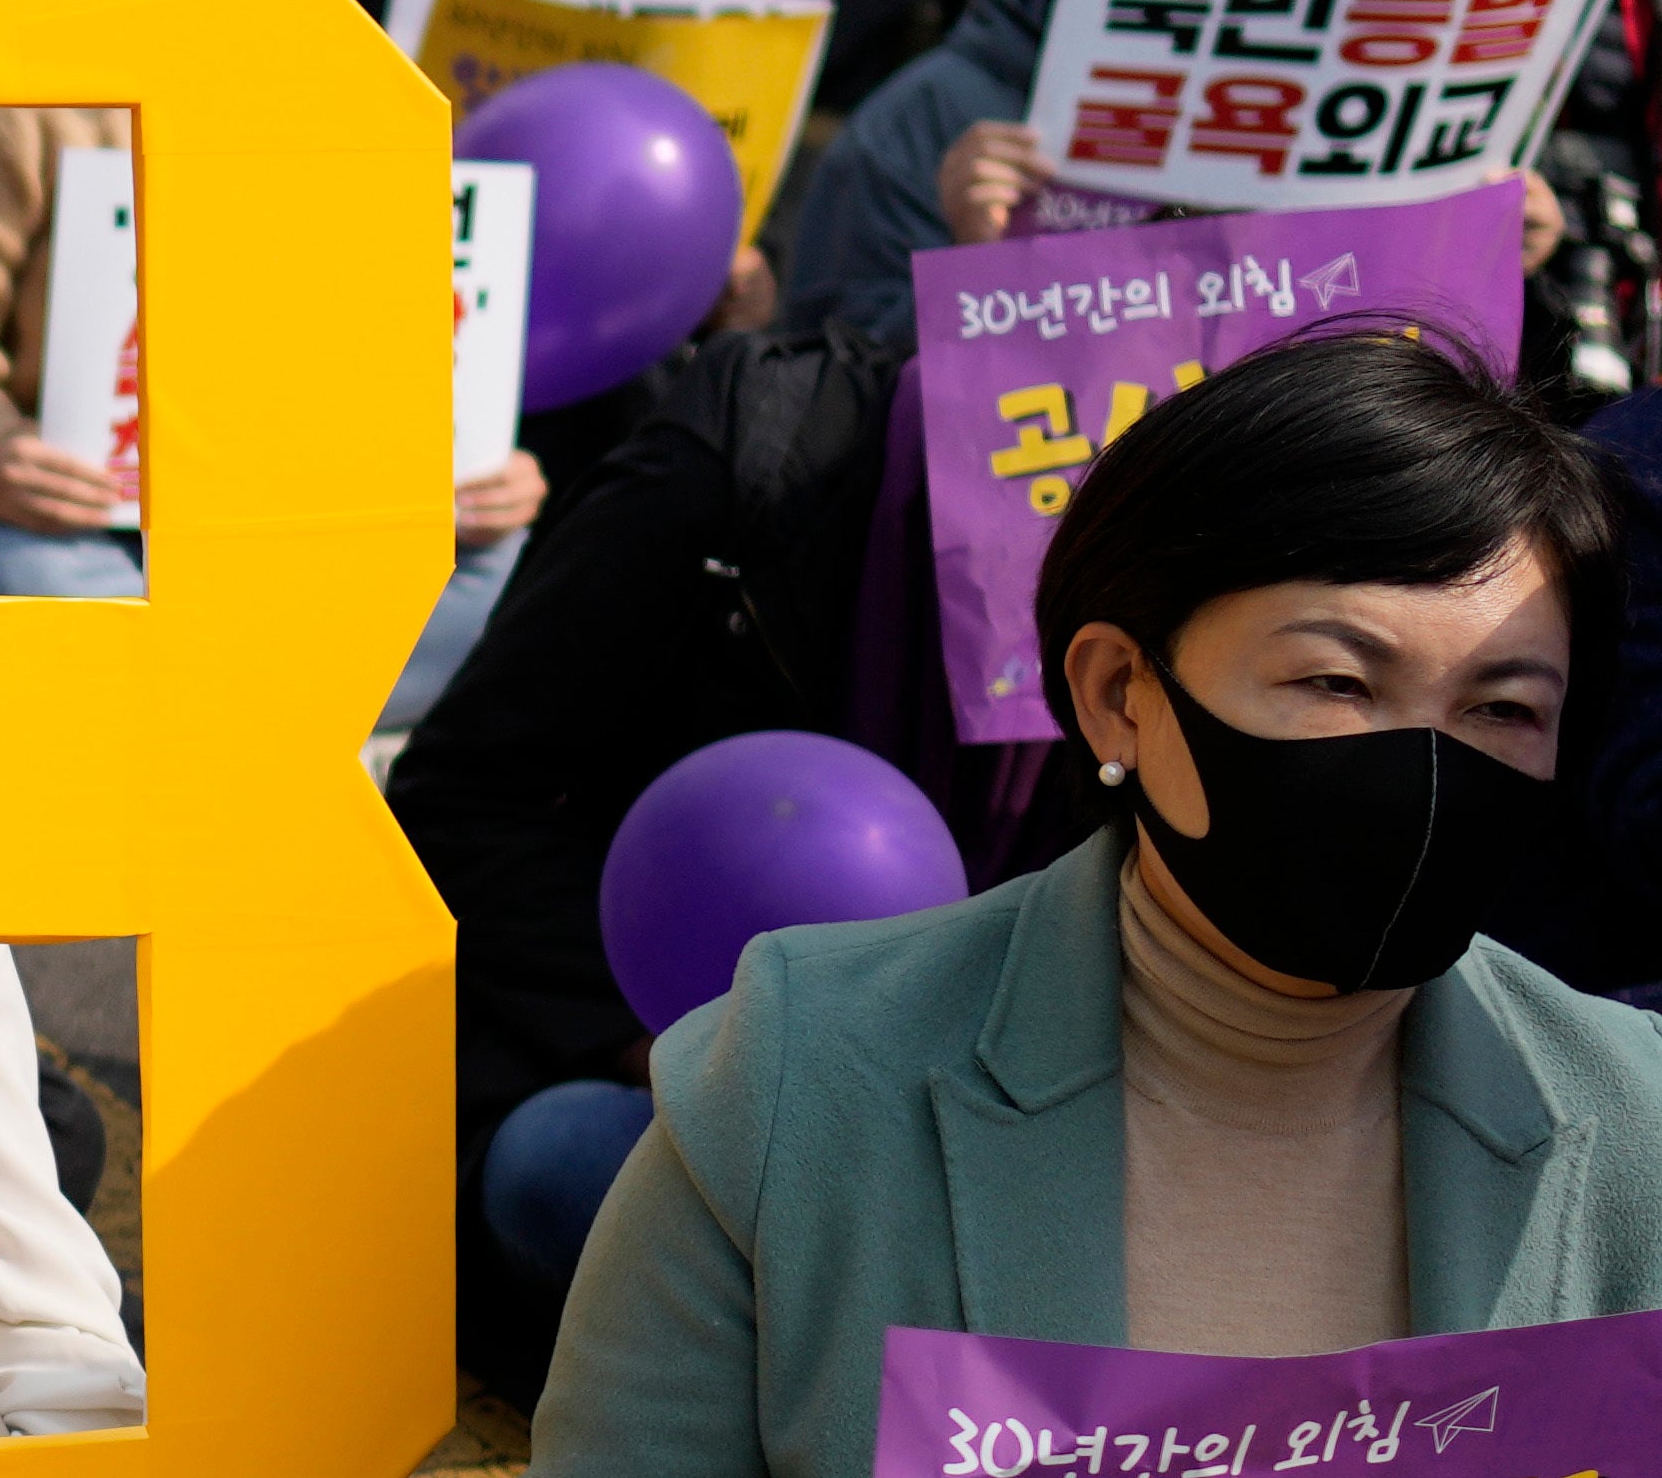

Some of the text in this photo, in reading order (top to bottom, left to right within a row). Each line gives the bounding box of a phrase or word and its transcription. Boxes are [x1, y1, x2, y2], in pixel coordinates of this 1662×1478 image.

[957, 255, 1296, 340] 30년간의 외침
[1274, 1399, 1413, 1474] 외침
